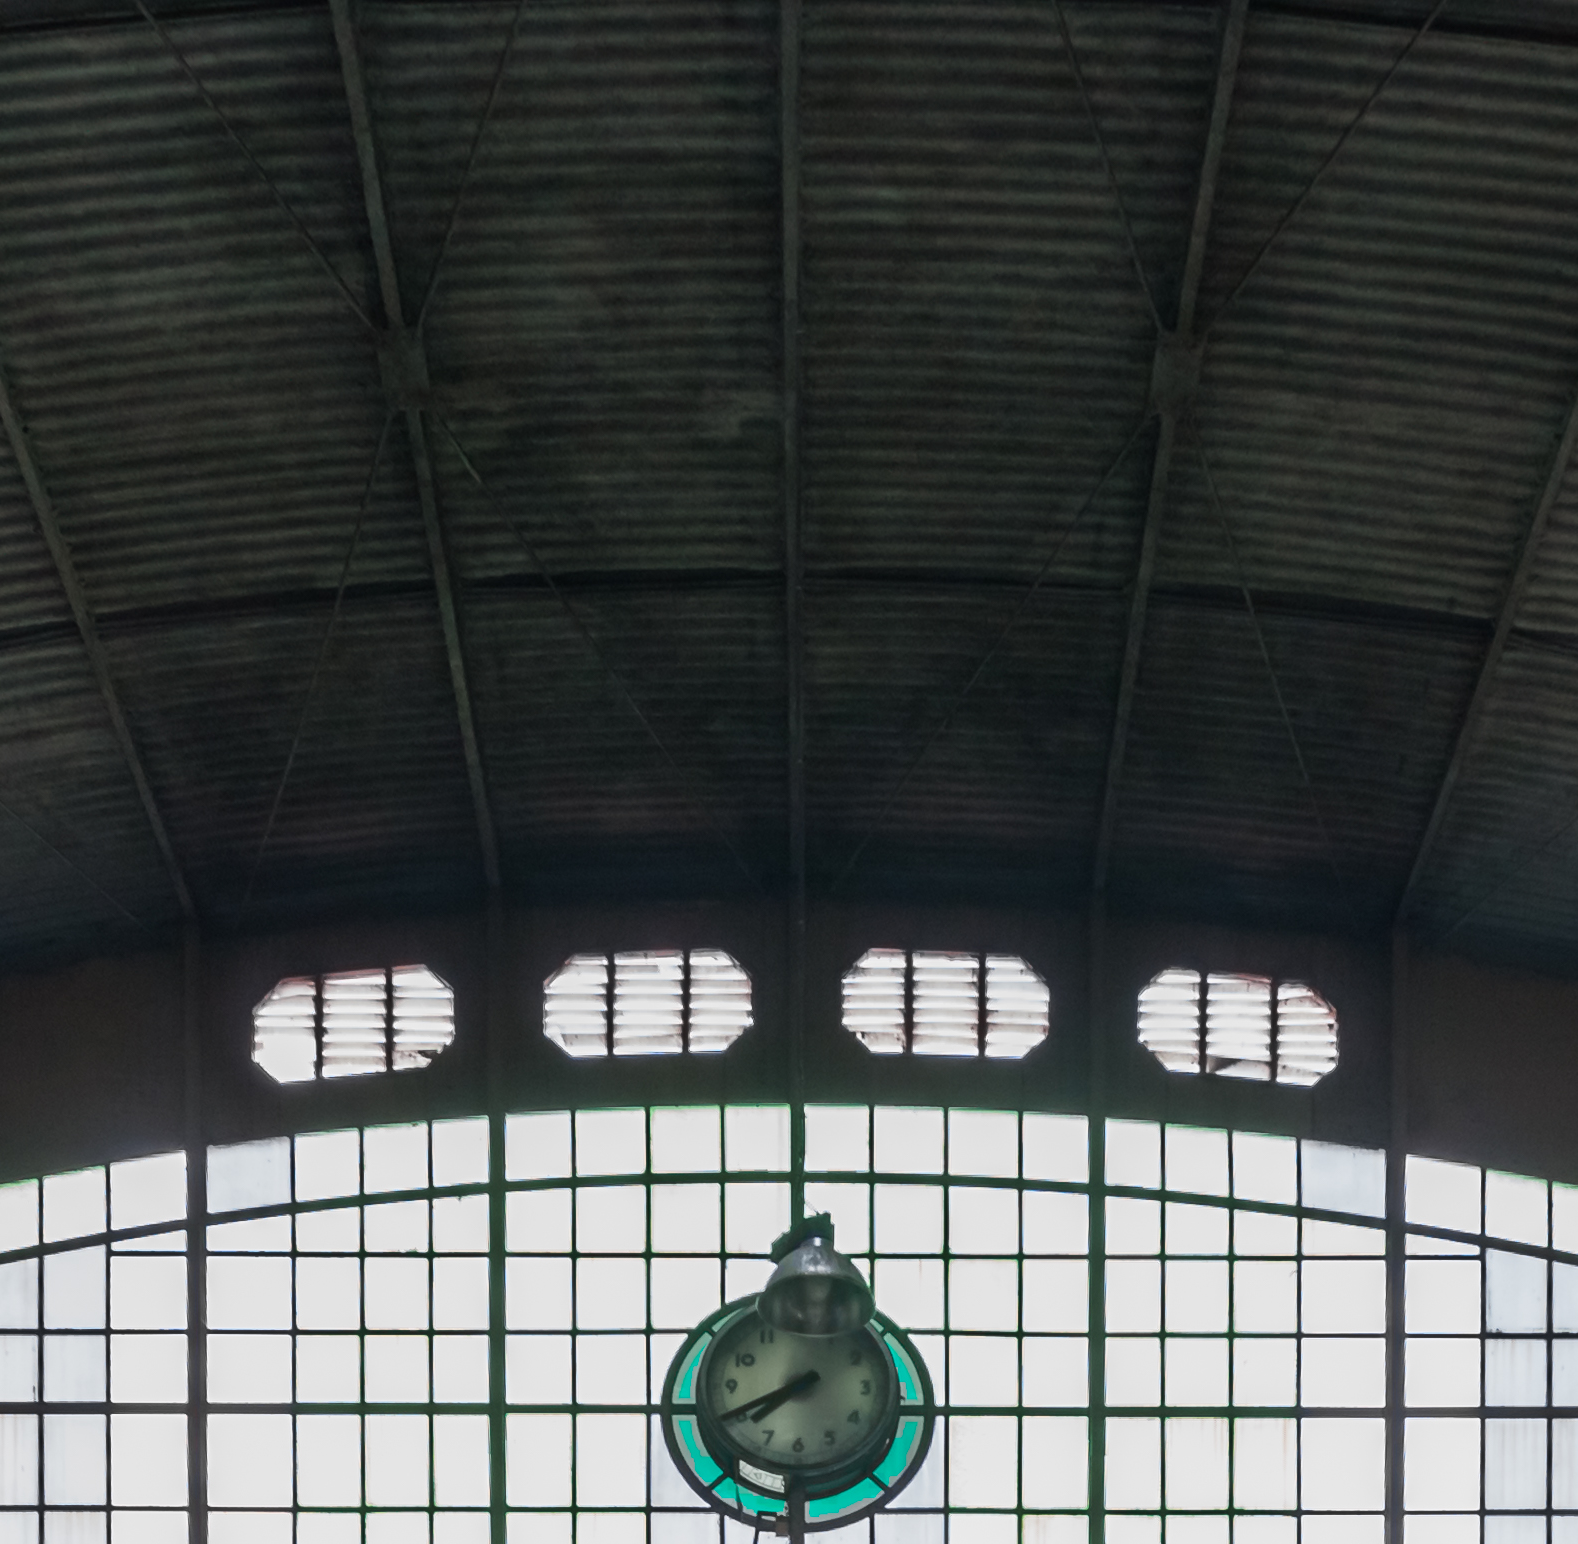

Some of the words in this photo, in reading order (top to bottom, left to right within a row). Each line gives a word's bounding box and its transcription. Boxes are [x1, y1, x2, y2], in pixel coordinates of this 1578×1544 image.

[760, 1330, 773, 1344] 11
[735, 1353, 755, 1368] 10
[725, 1379, 737, 1394] 9
[861, 1379, 872, 1395] 3
[847, 1409, 861, 1425] 4
[762, 1430, 775, 1446] 7
[792, 1437, 805, 1453] 6
[824, 1430, 835, 1446] 5
